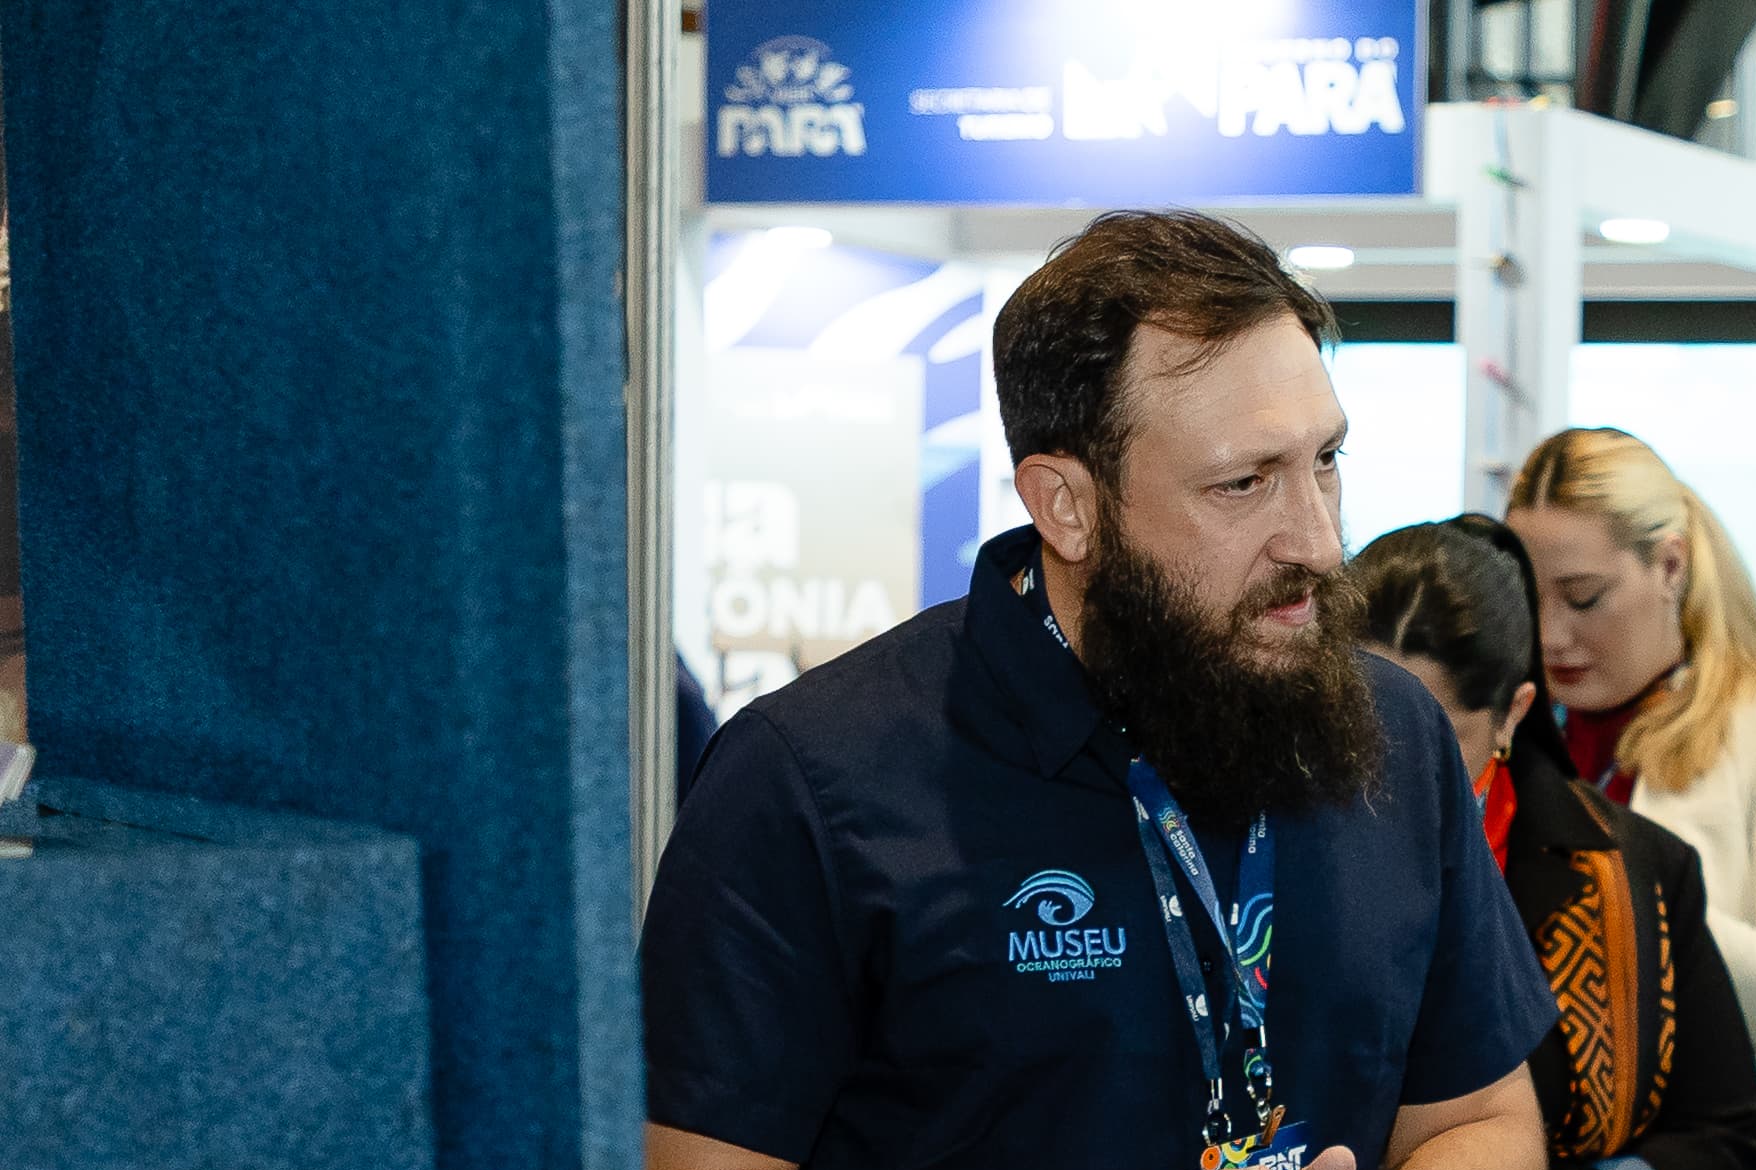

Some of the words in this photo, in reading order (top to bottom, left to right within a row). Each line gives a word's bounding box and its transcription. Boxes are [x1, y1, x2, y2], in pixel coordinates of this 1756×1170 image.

[1008, 926, 1127, 962] MUSEU
[1016, 956, 1122, 973] OCEANOGRÁFICO
[1047, 969, 1095, 983] UNIVALI
